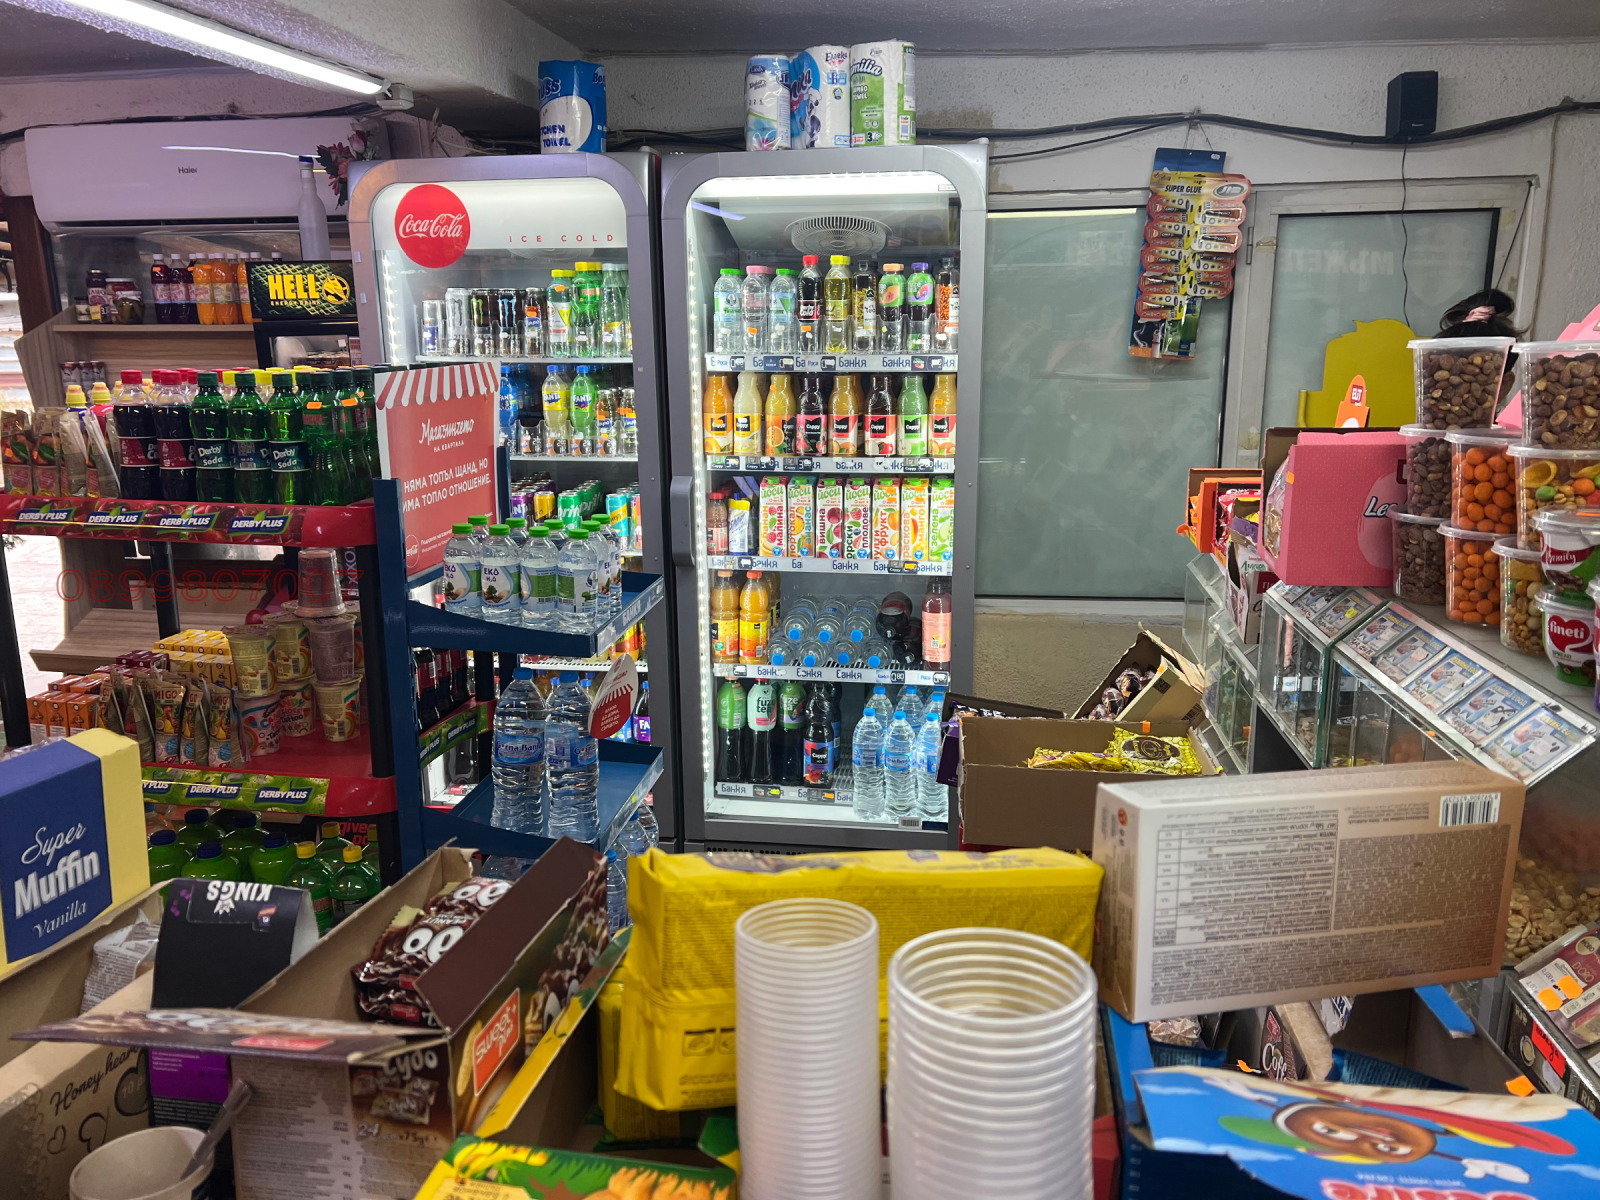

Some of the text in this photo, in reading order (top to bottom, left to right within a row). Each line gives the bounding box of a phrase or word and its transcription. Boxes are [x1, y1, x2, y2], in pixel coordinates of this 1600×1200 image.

[1165, 185, 1185, 193] SUPER
[399, 213, 466, 238] Coca-Cola
[509, 234, 614, 243] ICE COLD
[267, 273, 320, 300] HELL
[543, 392, 561, 401] FANTA
[573, 394, 592, 402] FANTA
[198, 445, 222, 457] Derby
[272, 448, 295, 460] Derby
[202, 456, 223, 466] Soda
[277, 459, 297, 469] Soda
[403, 478, 428, 494] НЯМА
[429, 472, 455, 486] ТОПЪЛ
[479, 457, 489, 470] НО
[402, 499, 421, 513] ИМА
[422, 487, 448, 506] ТОПЛО
[18, 512, 68, 521] DERBY PLUS
[88, 514, 138, 524] DERBY PLUS
[160, 517, 210, 527] DERBY PLUS
[232, 518, 284, 529] DERBY PLUS
[776, 505, 784, 546] малина
[804, 506, 812, 544] ананас
[879, 511, 889, 547] фрукт
[918, 508, 926, 542] манго
[931, 508, 939, 547] зелена
[846, 526, 855, 559] орски
[1549, 620, 1585, 639] fineti
[1552, 649, 1572, 659] SPREAD
[757, 666, 777, 677] Банк
[154, 690, 178, 700] MIGO
[190, 785, 238, 794] DERBY PLUS
[259, 791, 308, 800] DERBY PLUS
[21, 822, 87, 866] Super
[14, 850, 101, 919] Muffin
[207, 880, 273, 902] KINGS
[33, 901, 88, 939] Vanilla
[475, 1013, 512, 1064] sweet
[50, 1071, 104, 1116] Honey
